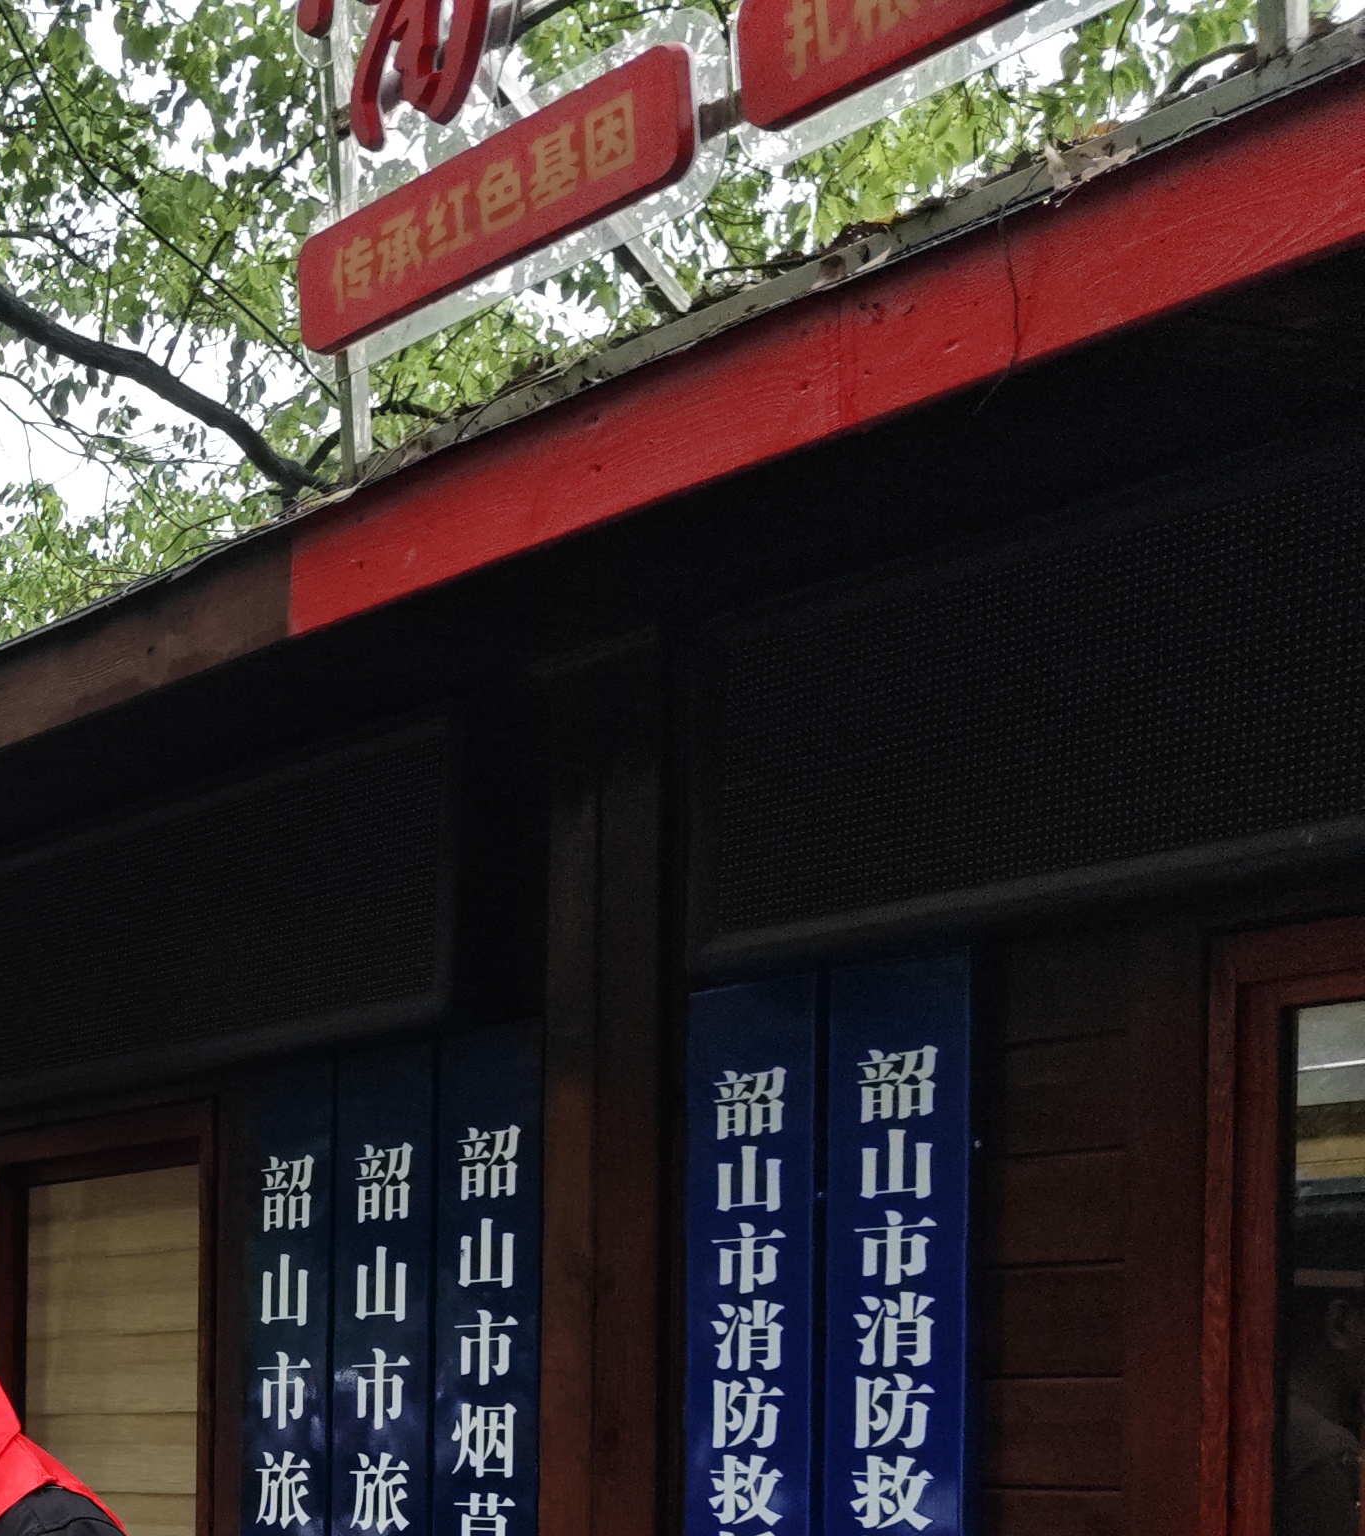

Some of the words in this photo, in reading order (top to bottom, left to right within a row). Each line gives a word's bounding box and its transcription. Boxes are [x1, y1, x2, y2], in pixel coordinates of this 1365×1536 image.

[331, 94, 635, 314] 传承红色基因
